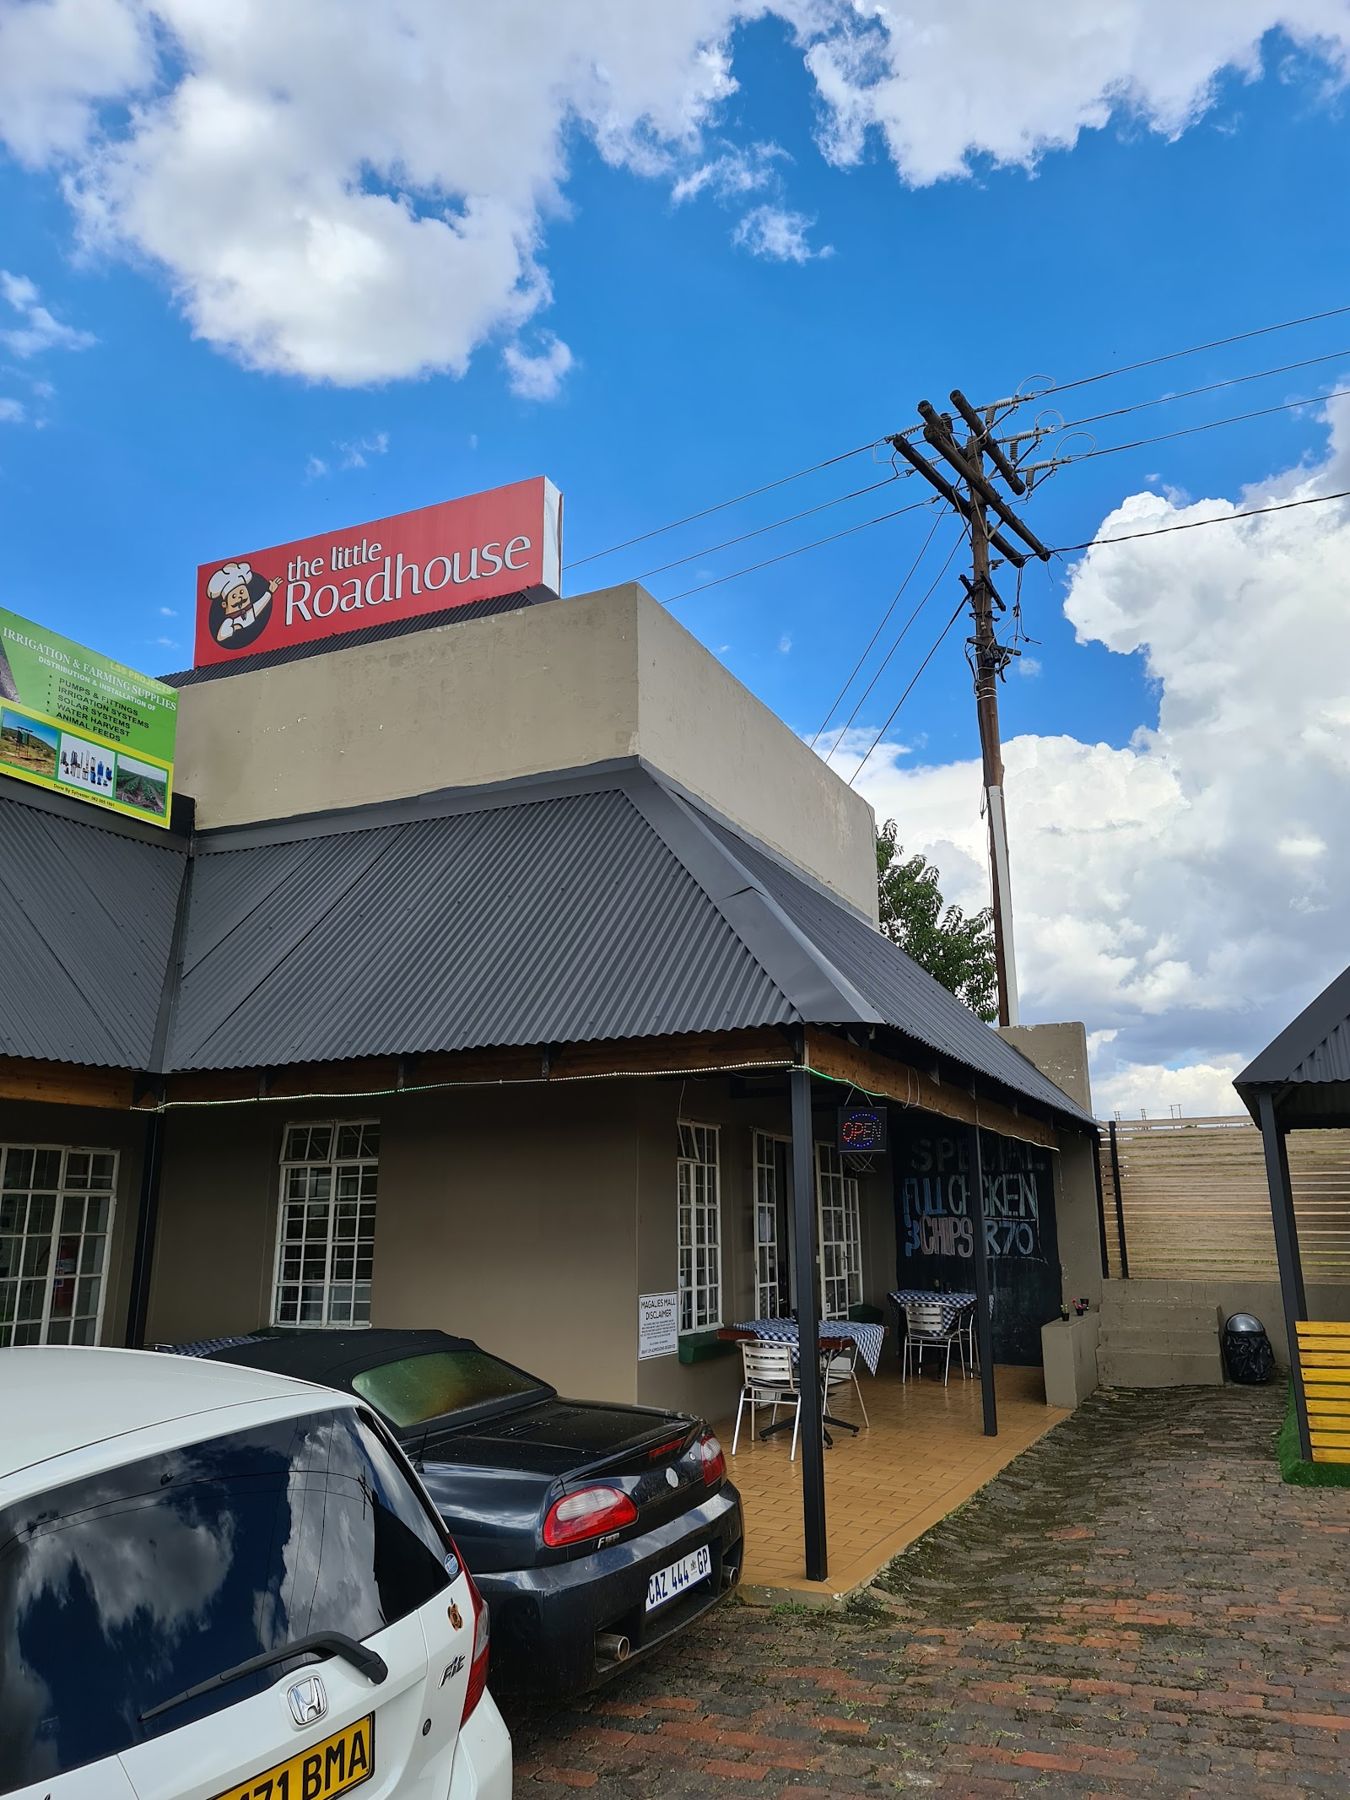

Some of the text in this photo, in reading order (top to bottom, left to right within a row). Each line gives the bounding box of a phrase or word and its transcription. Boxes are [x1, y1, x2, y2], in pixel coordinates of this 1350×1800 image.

[284, 534, 533, 627] Roadhouse
[287, 538, 383, 583] the little
[3, 627, 71, 665] IRRIGATION
[72, 659, 81, 670] &
[83, 663, 130, 691] FARMING
[132, 685, 177, 712] SUPPLIES
[39, 656, 91, 684] DISTRIBUTION
[91, 679, 98, 687] &
[99, 682, 147, 708] INSTALLATION
[147, 703, 156, 711] OF
[57, 694, 131, 730] SOLAR SYSTEMS
[58, 686, 150, 729] IRRIGATION SYSTEMS
[59, 677, 139, 717] PUMPS & FITTINGS
[56, 712, 121, 742] ANIMAL FEEDS
[57, 703, 131, 737] WATER HARVEST
[842, 1122, 882, 1141] OPEN
[948, 1171, 1039, 1217] CHCKEN
[919, 1215, 974, 1258] CHIPS
[645, 1309, 672, 1321] DISCLAIMER
[664, 1297, 676, 1306] MALL
[648, 1548, 709, 1605] CAZ 444 GP
[239, 1729, 368, 1800] 71 BMA
